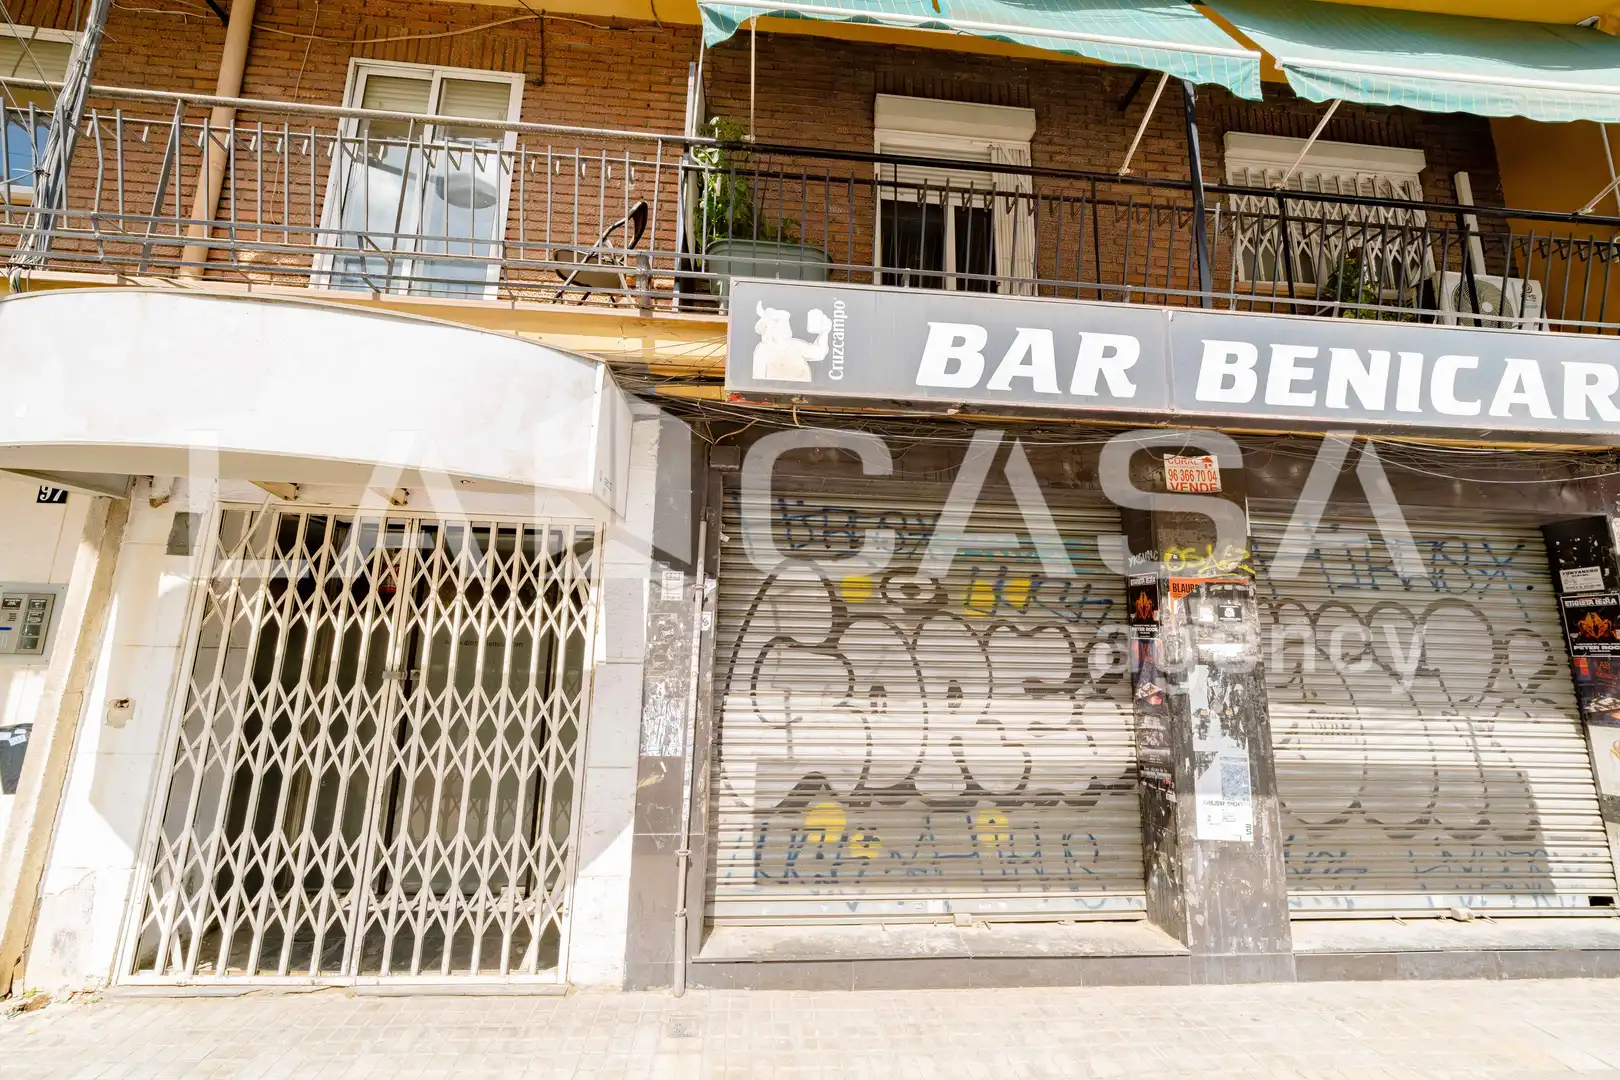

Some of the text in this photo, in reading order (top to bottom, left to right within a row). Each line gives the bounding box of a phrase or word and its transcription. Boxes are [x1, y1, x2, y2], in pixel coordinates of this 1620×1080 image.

[828, 300, 848, 381] Cruzcampo
[916, 321, 1620, 422] BAR BENICAR
[1168, 468, 1217, 482] 96 366 70 04
[39, 485, 64, 502] 97
[1170, 481, 1218, 492] VENDE
